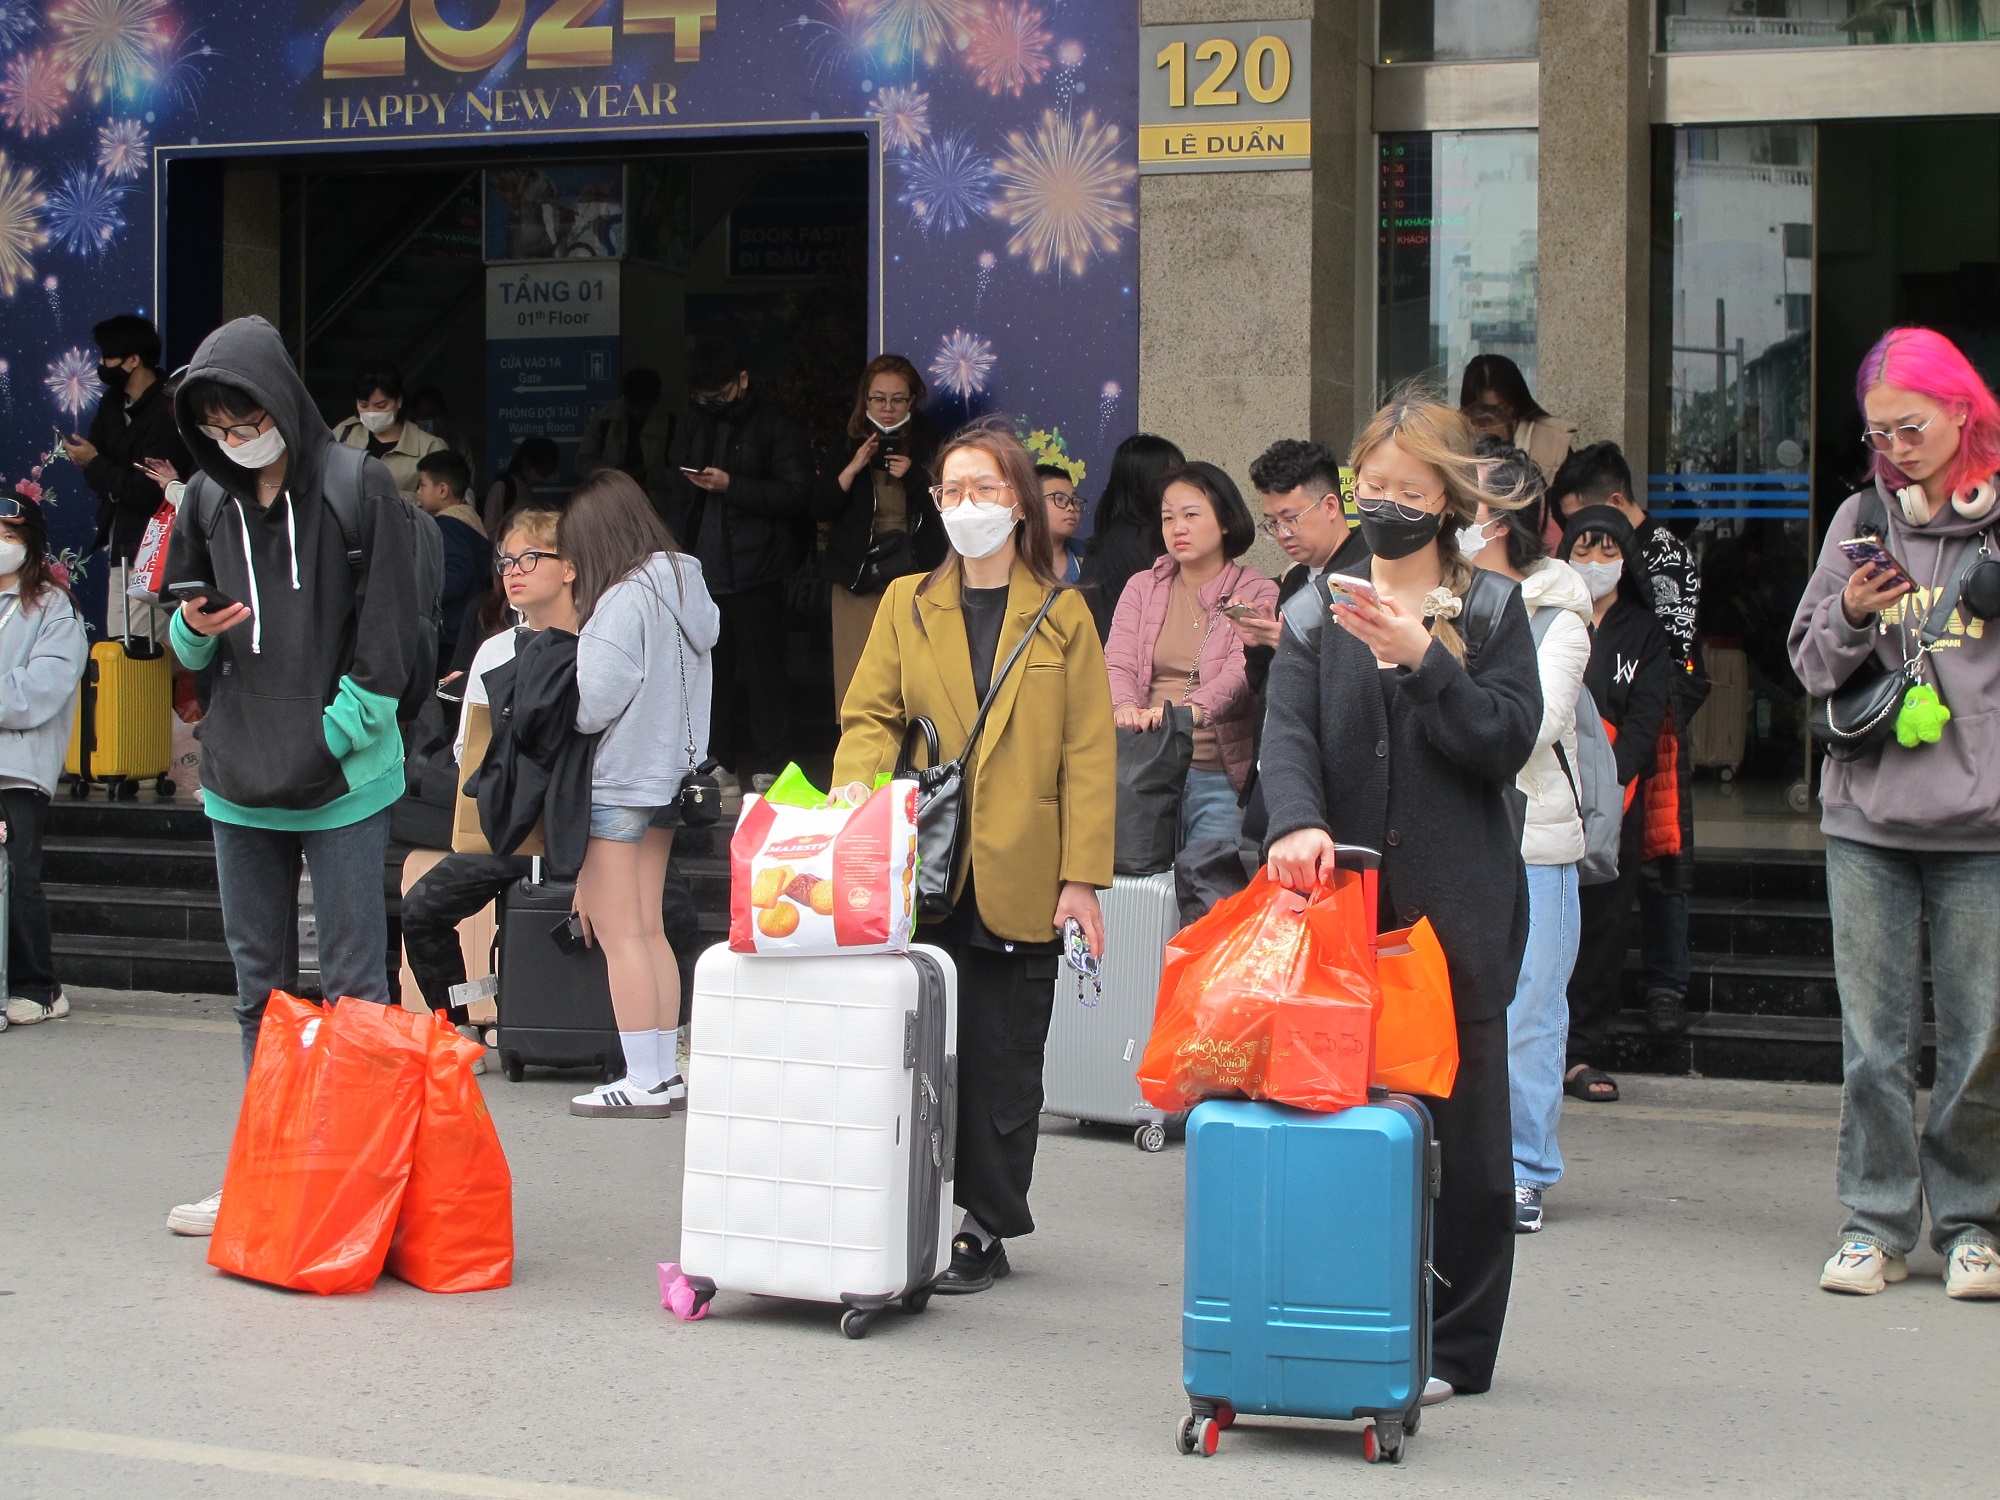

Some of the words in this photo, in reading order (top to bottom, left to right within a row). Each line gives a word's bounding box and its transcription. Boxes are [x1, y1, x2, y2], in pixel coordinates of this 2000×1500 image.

[1157, 35, 1291, 107] 120
[322, 92, 454, 129] HAPPY
[465, 87, 562, 123] NEW
[567, 83, 678, 119] YEAR
[1164, 133, 1197, 155] LÊ
[1207, 125, 1285, 153] DUẨN
[739, 227, 794, 243] BOOK
[1397, 233, 1428, 244] KHÁCH
[499, 274, 570, 304] TẦNG
[579, 280, 603, 302] 01
[517, 311, 546, 326] 01th
[548, 310, 589, 325] Floor
[524, 355, 546, 368] VÀO
[549, 357, 562, 368] 1A
[519, 372, 542, 384] Gate
[498, 403, 536, 418] PHÒNG
[559, 402, 579, 417] TÀU
[508, 422, 544, 436] Waiting
[547, 421, 575, 433] Room
[1219, 1075, 1245, 1086] HAPPY
